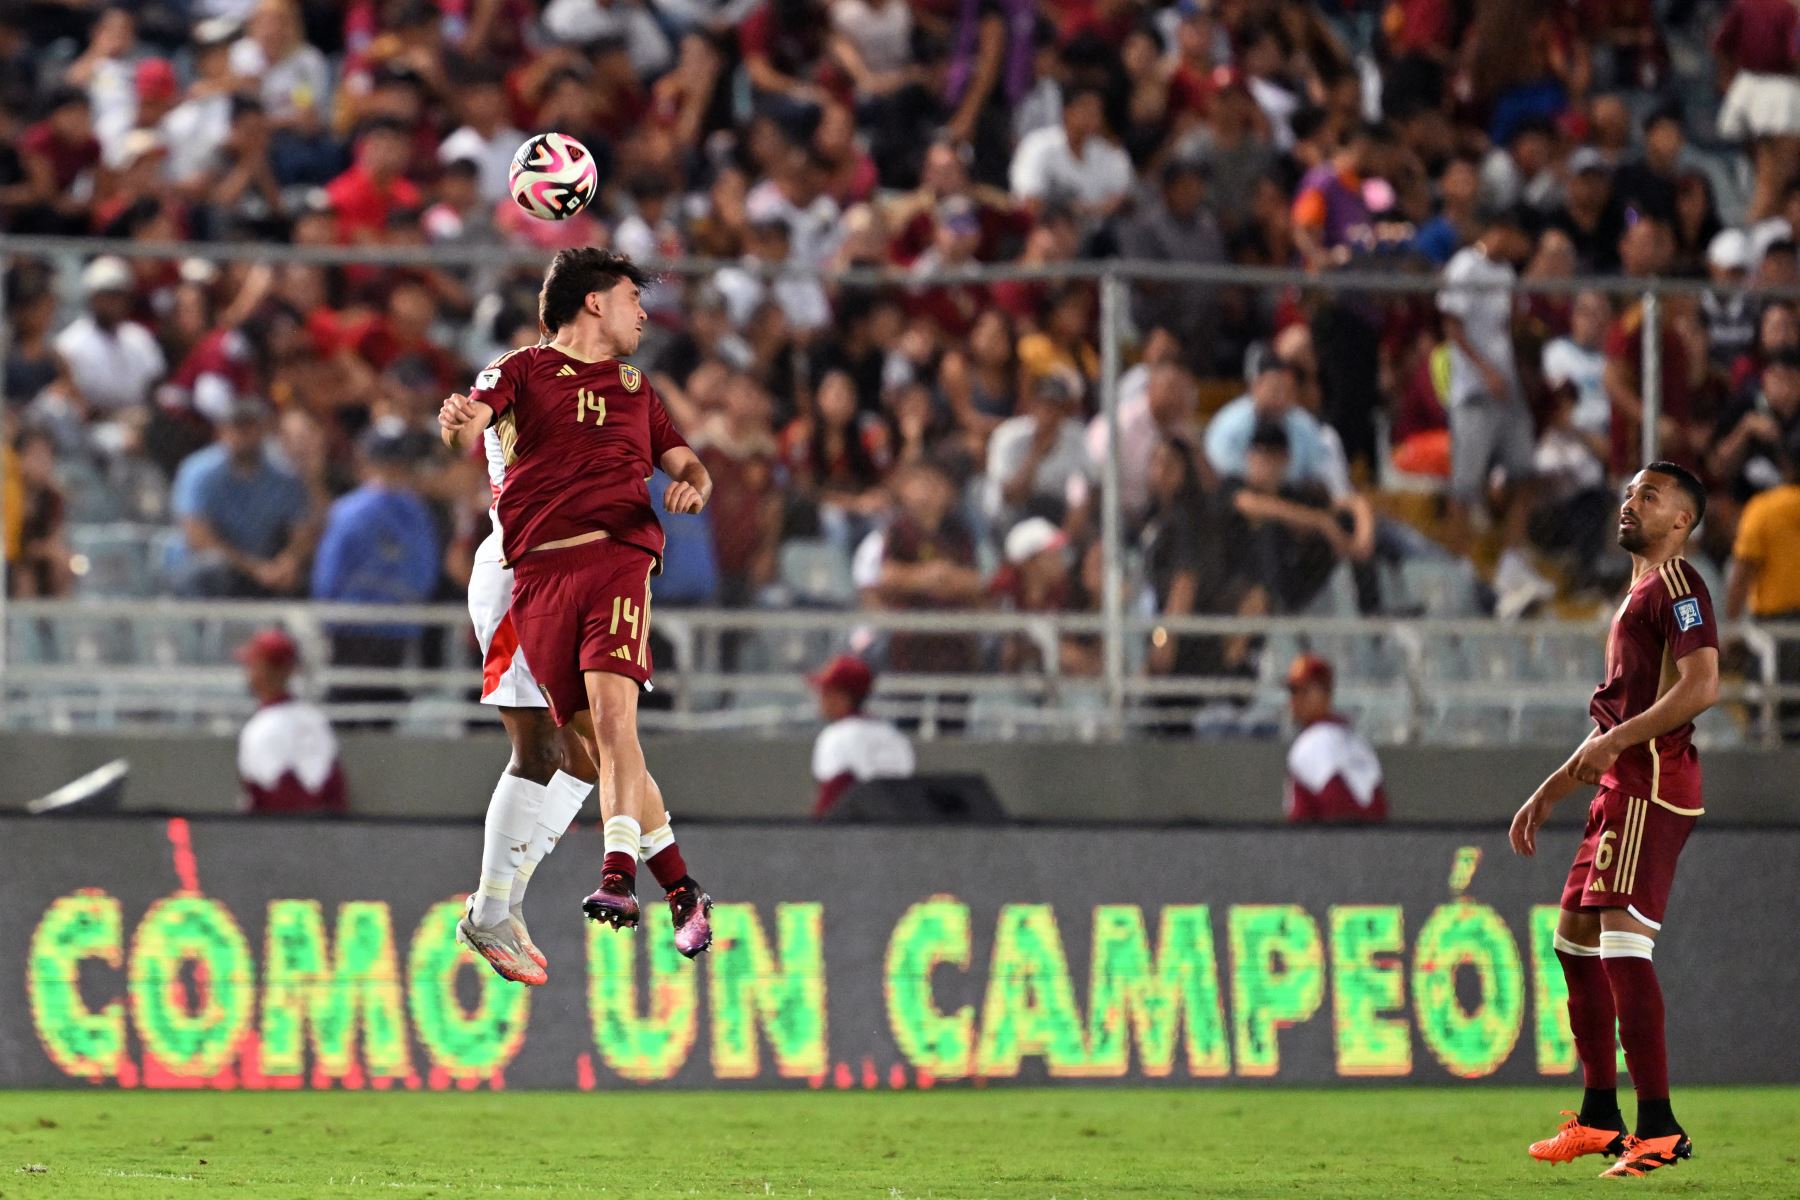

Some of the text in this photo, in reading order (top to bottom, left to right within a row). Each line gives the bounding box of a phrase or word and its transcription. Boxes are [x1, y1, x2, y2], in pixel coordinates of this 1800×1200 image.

[577, 387, 606, 426] 14
[609, 596, 640, 640] 14
[1595, 830, 1617, 870] 6
[586, 900, 829, 1080] UN
